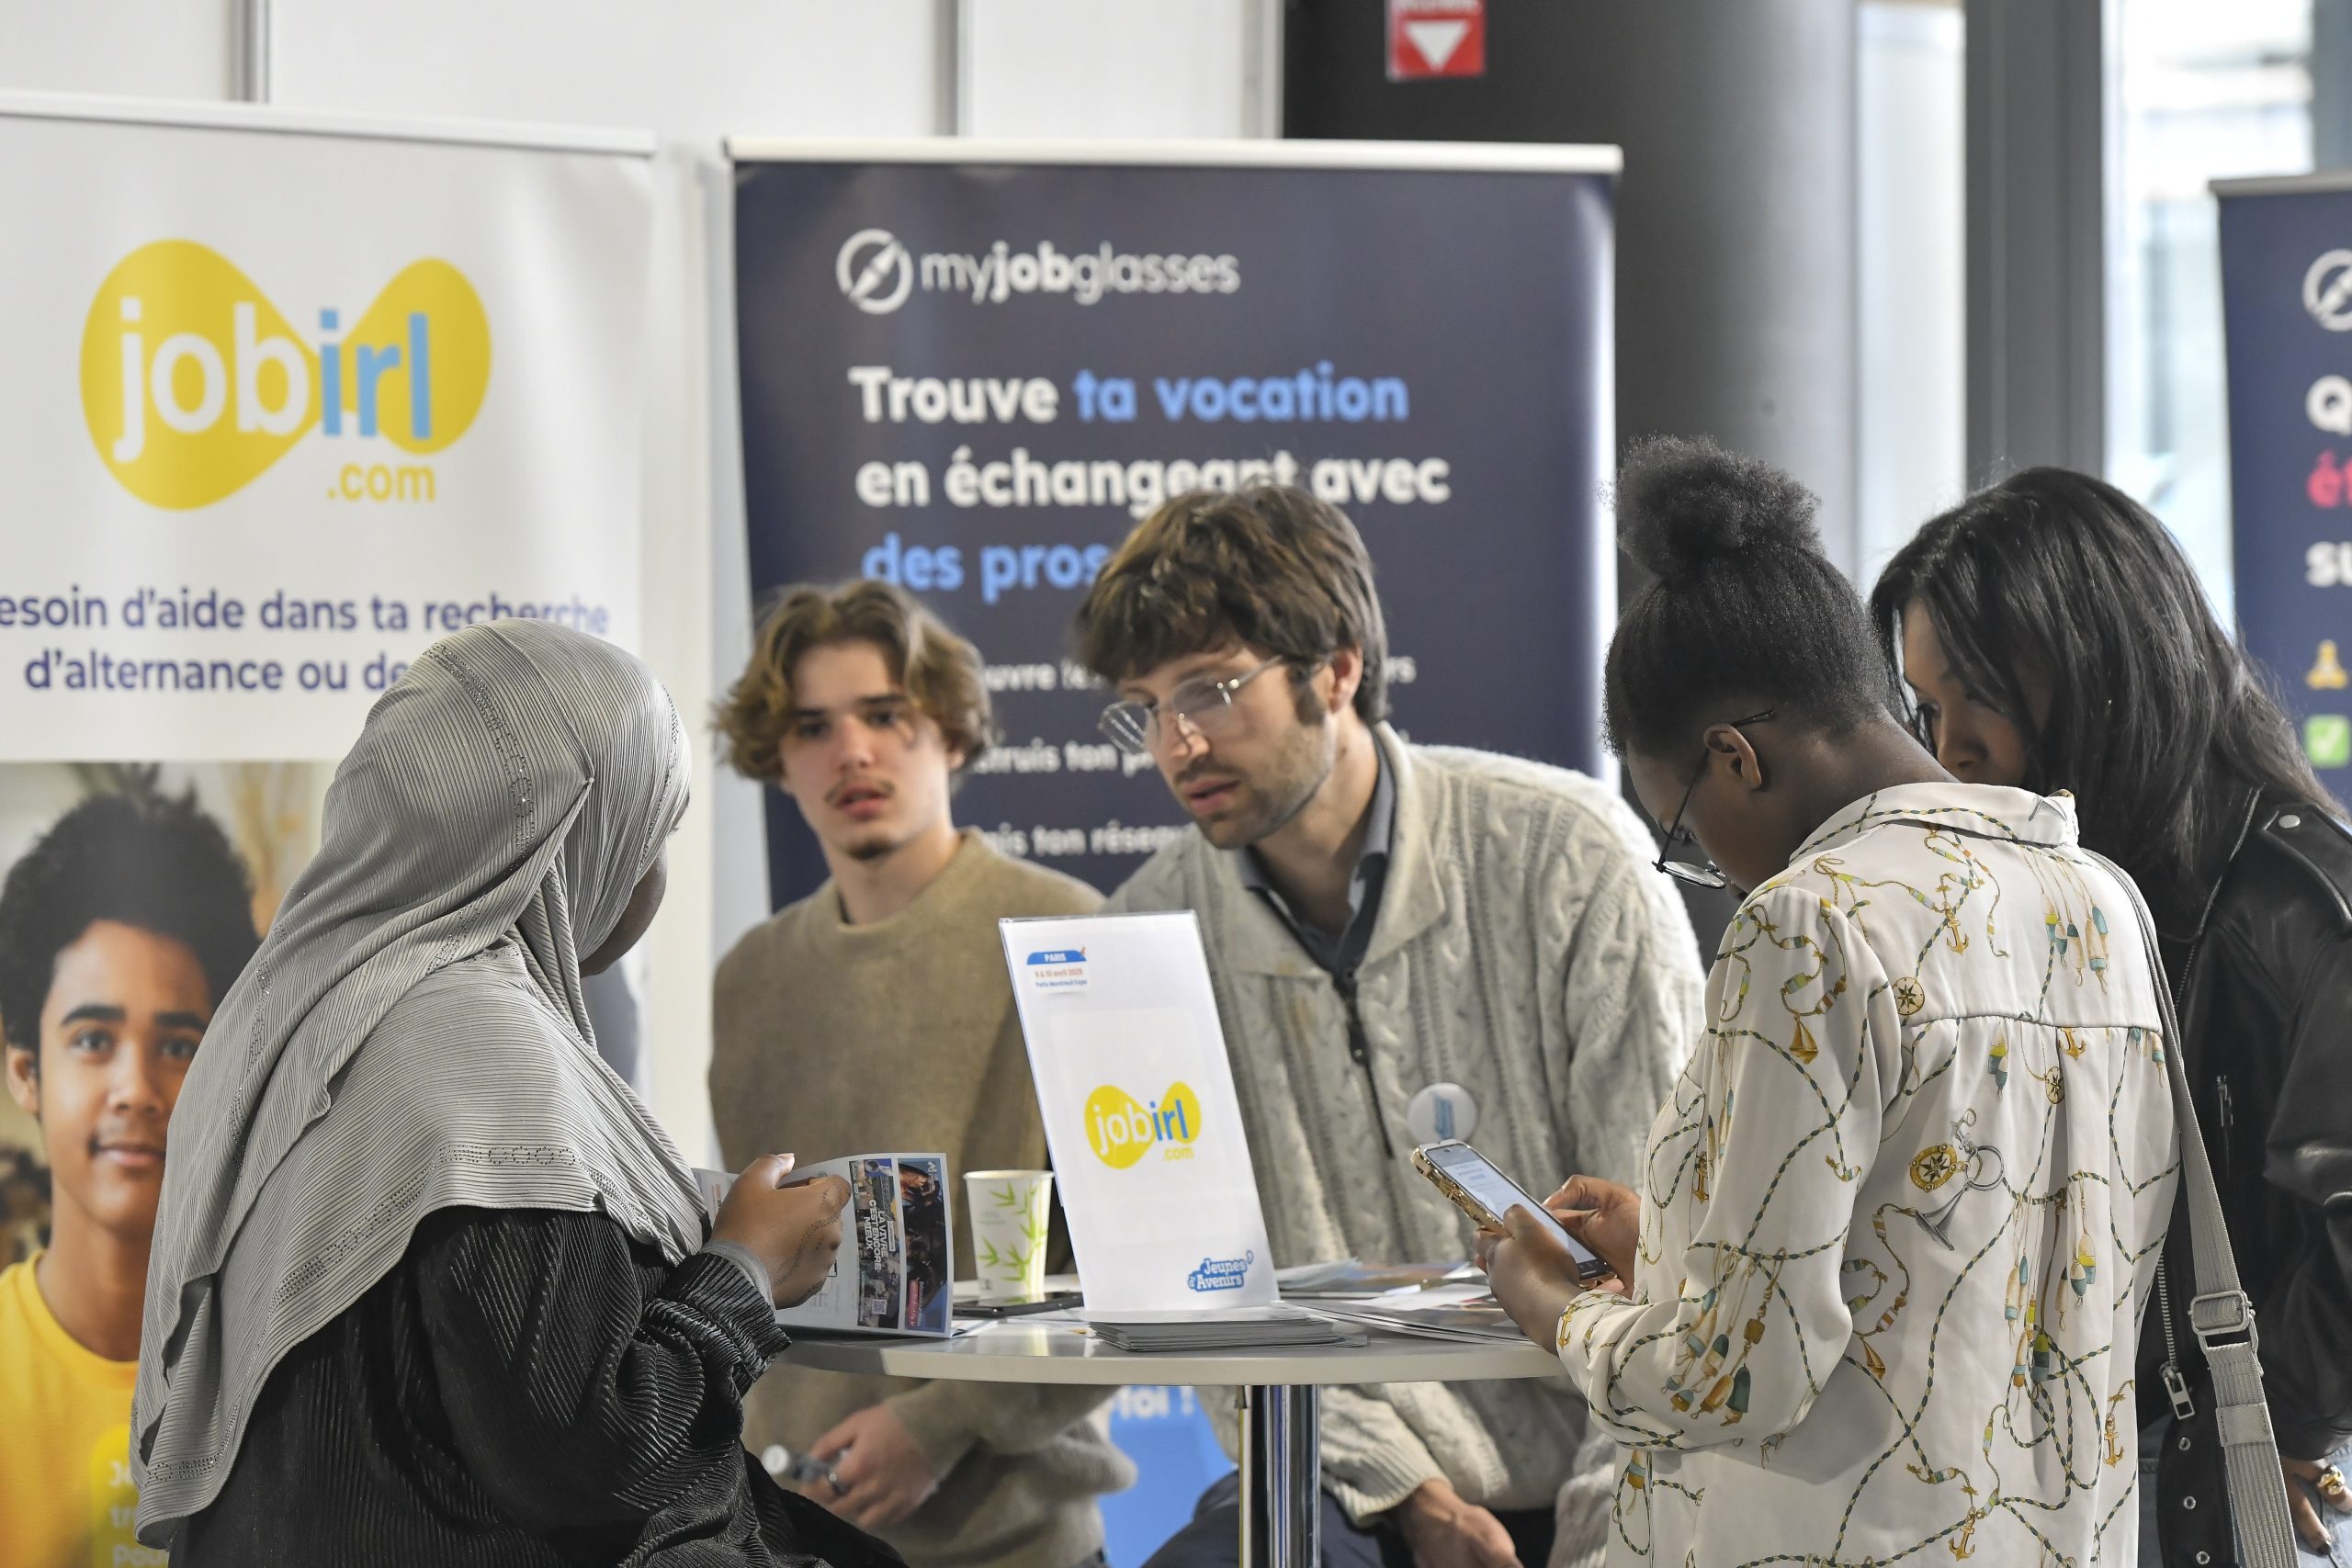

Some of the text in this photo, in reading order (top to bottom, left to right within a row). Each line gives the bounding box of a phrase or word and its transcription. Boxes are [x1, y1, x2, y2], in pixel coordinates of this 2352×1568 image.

[921, 240, 1240, 305] myjobglasses
[111, 294, 434, 465] jobirl
[848, 358, 1410, 423] Trouve ta vocation
[326, 463, 437, 502] .com
[855, 459, 930, 506] en
[1311, 457, 1452, 504] avec
[861, 531, 965, 591] des
[122, 588, 245, 629] d'aide
[260, 592, 356, 631] dans
[371, 593, 409, 632] ta
[25, 649, 284, 692] d'alternance
[298, 658, 348, 692] ou
[1093, 1099, 1189, 1156] jobirl
[863, 1216, 874, 1250] MIEUX
[870, 1227, 882, 1270] ENCORE
[879, 1225, 888, 1258] VIVRE
[1204, 1258, 1246, 1275] Jeunes
